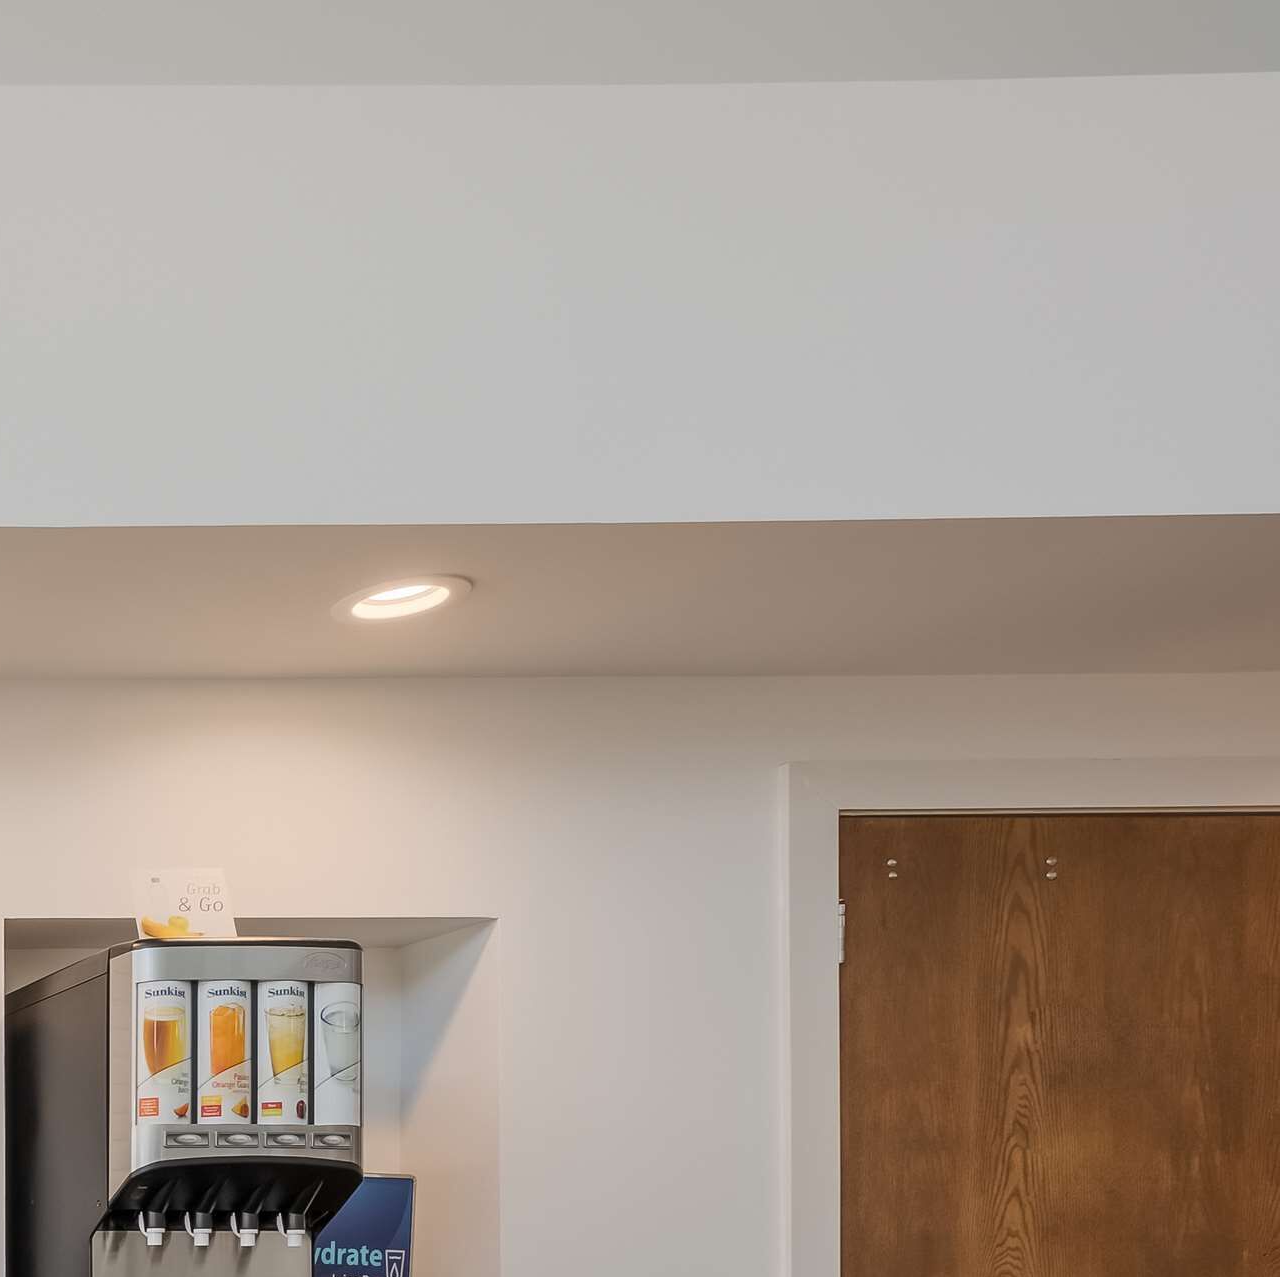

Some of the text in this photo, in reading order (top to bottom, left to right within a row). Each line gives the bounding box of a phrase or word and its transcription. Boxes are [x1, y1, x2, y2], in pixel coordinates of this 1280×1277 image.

[178, 896, 224, 912] & Go
[145, 986, 186, 999] Sunkist
[207, 986, 247, 999] Sunkist
[267, 986, 305, 998] Sunkist
